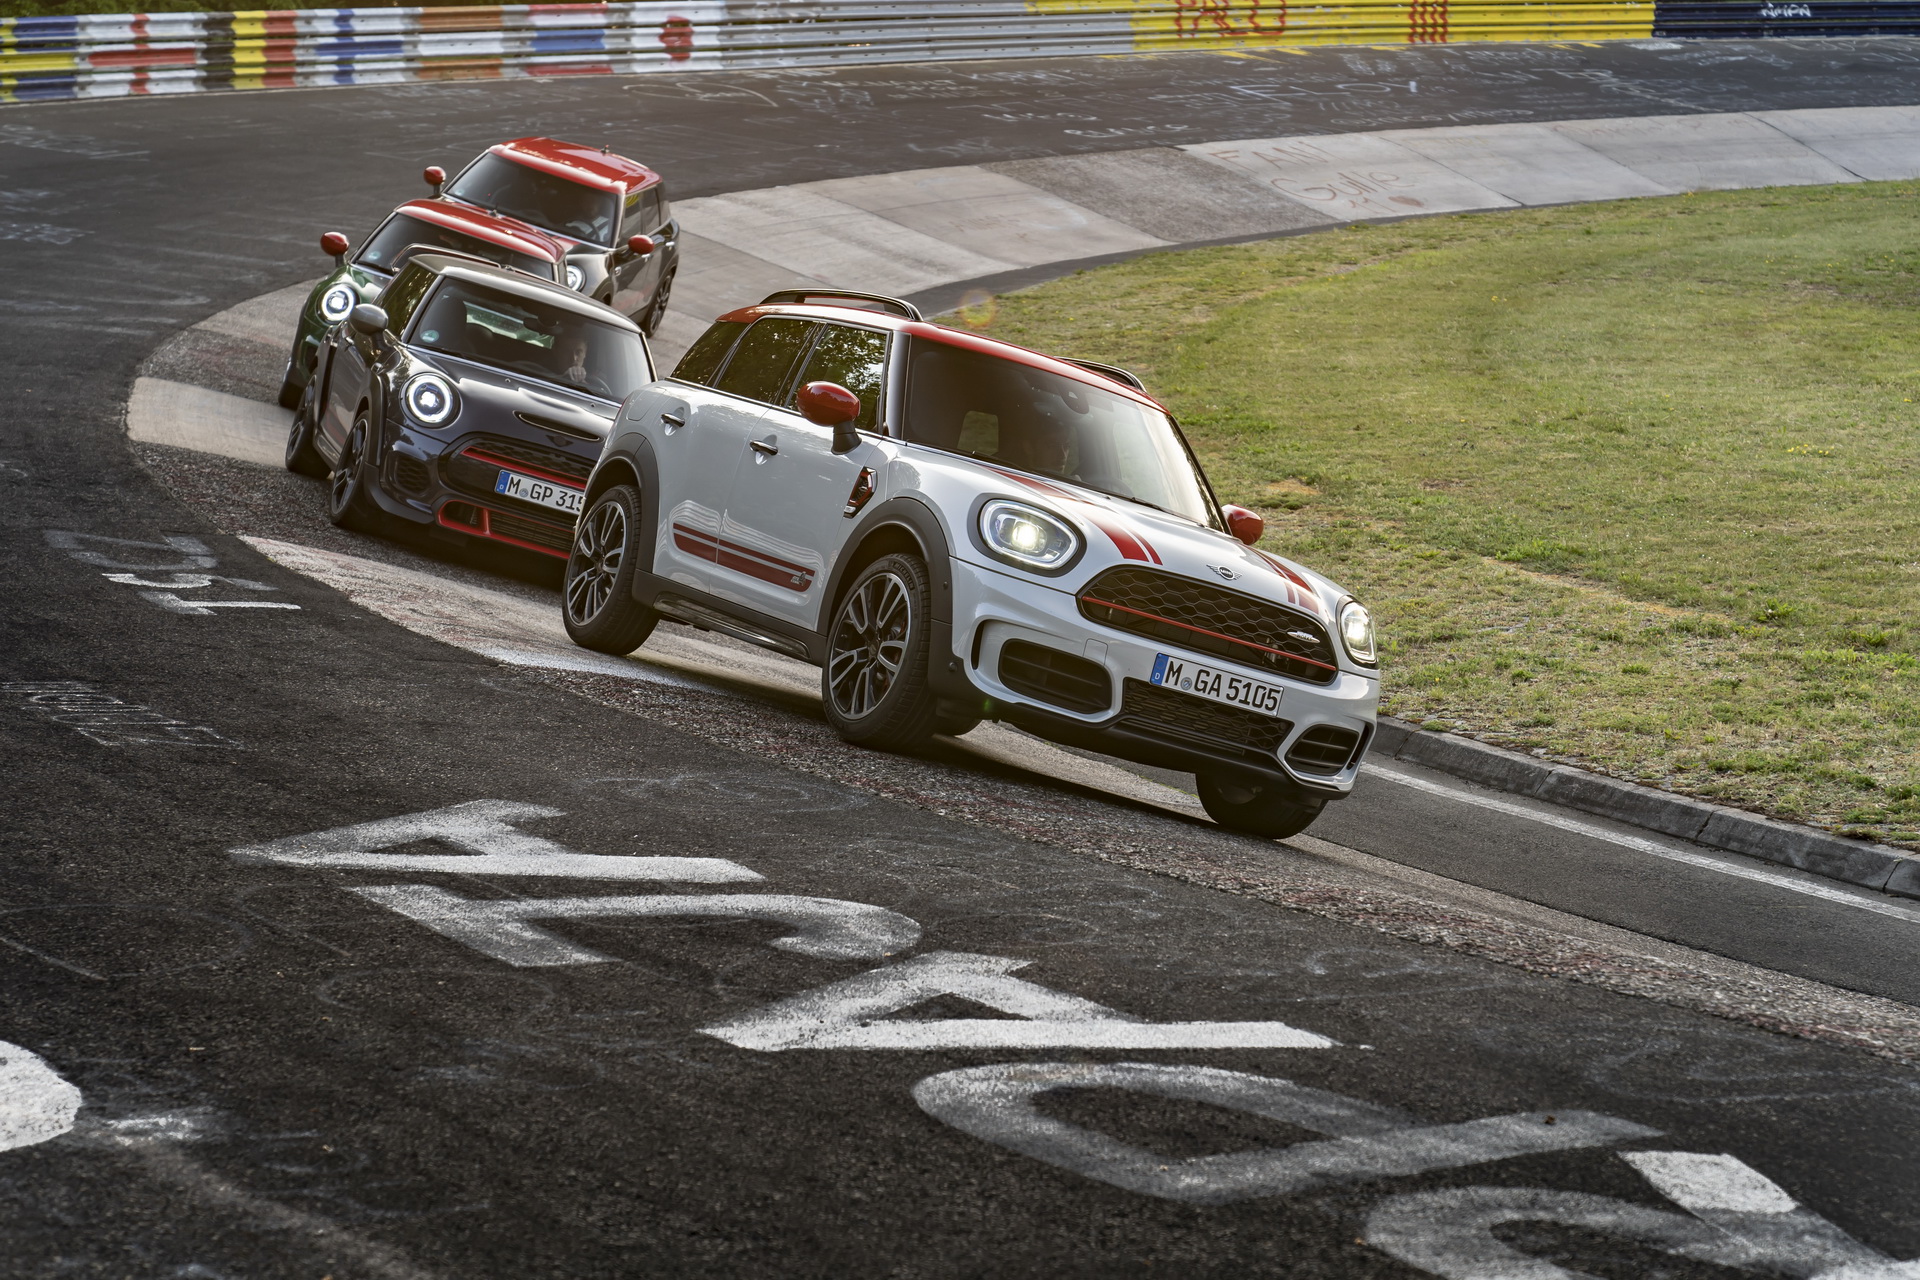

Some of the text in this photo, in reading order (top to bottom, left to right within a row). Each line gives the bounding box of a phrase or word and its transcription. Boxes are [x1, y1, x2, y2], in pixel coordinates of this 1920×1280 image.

[507, 476, 521, 495] M
[530, 483, 553, 502] GP
[1165, 662, 1184, 685] M
[1193, 668, 1221, 698] GA
[1225, 677, 1280, 712] 5105
